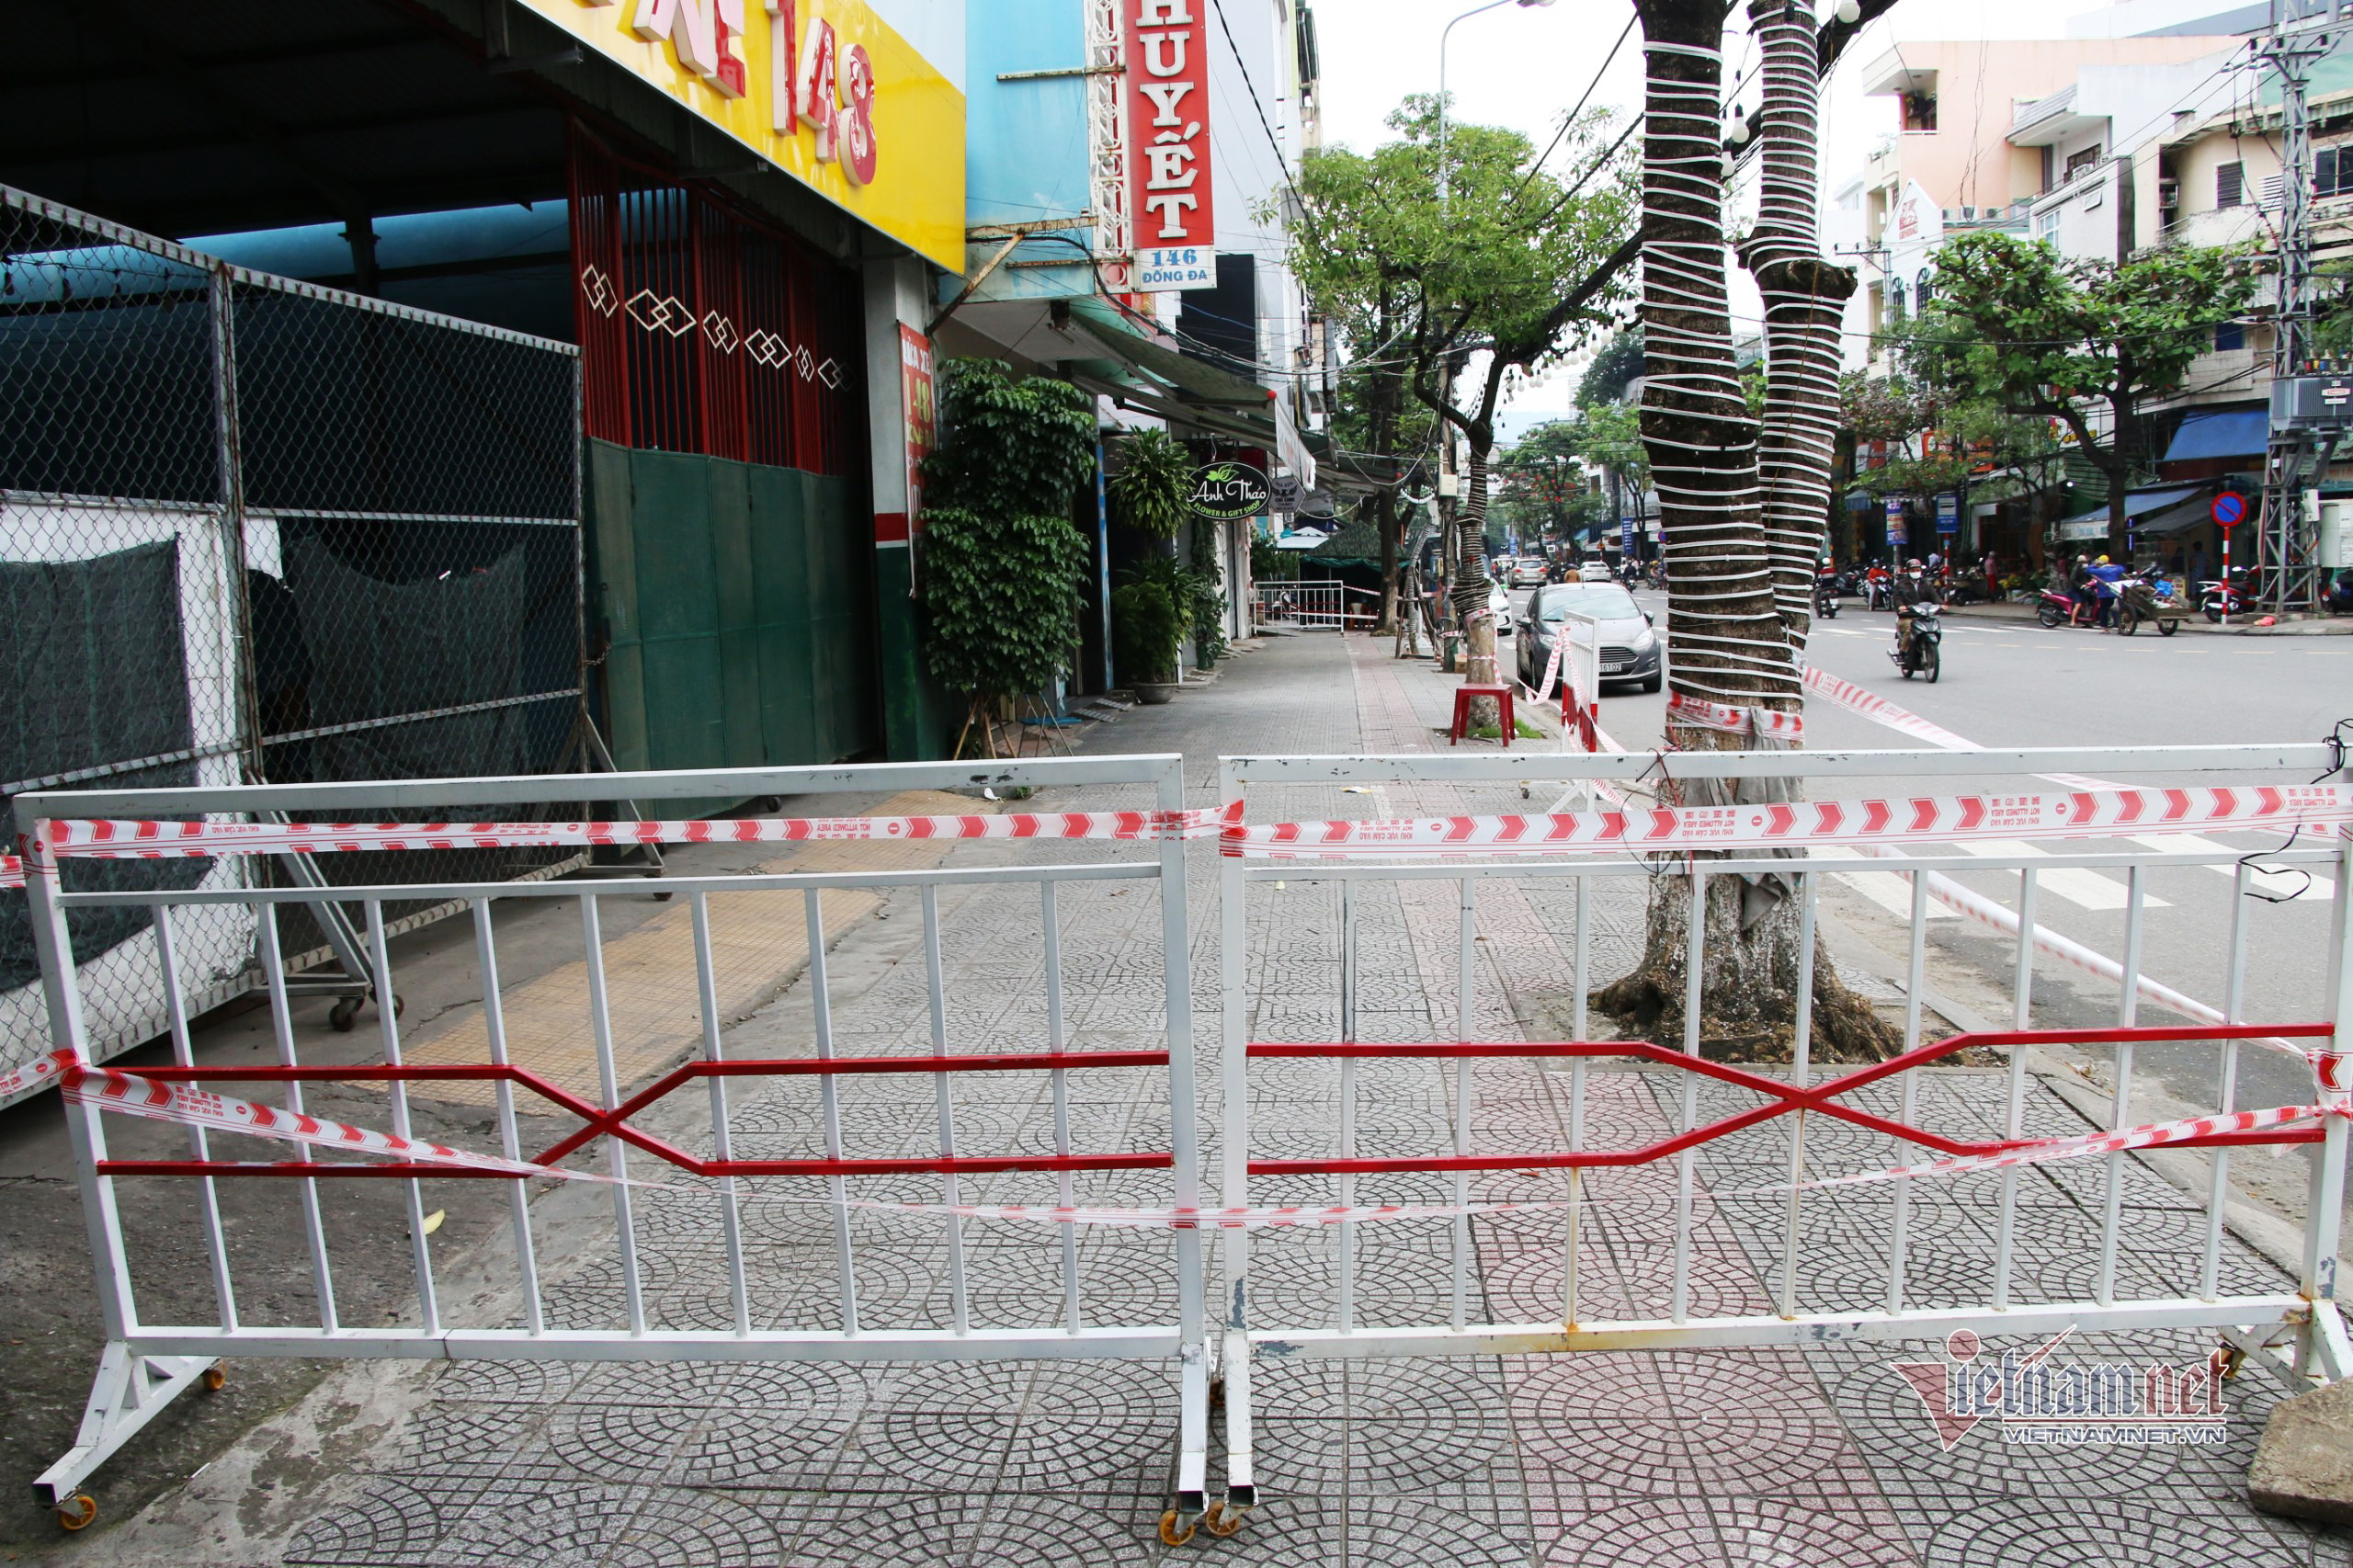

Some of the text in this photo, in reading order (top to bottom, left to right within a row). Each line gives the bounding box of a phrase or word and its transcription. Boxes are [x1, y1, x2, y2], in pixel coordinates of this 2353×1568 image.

[765, 0, 878, 187] 148
[1151, 249, 1198, 267] 146
[1142, 267, 1208, 283] ĐỐNG ĐA
[1187, 479, 1267, 502] Anh Thảo
[1193, 502, 1221, 517] FLOWER
[1227, 509, 1243, 517] GIFT
[1244, 500, 1260, 514] SHOP
